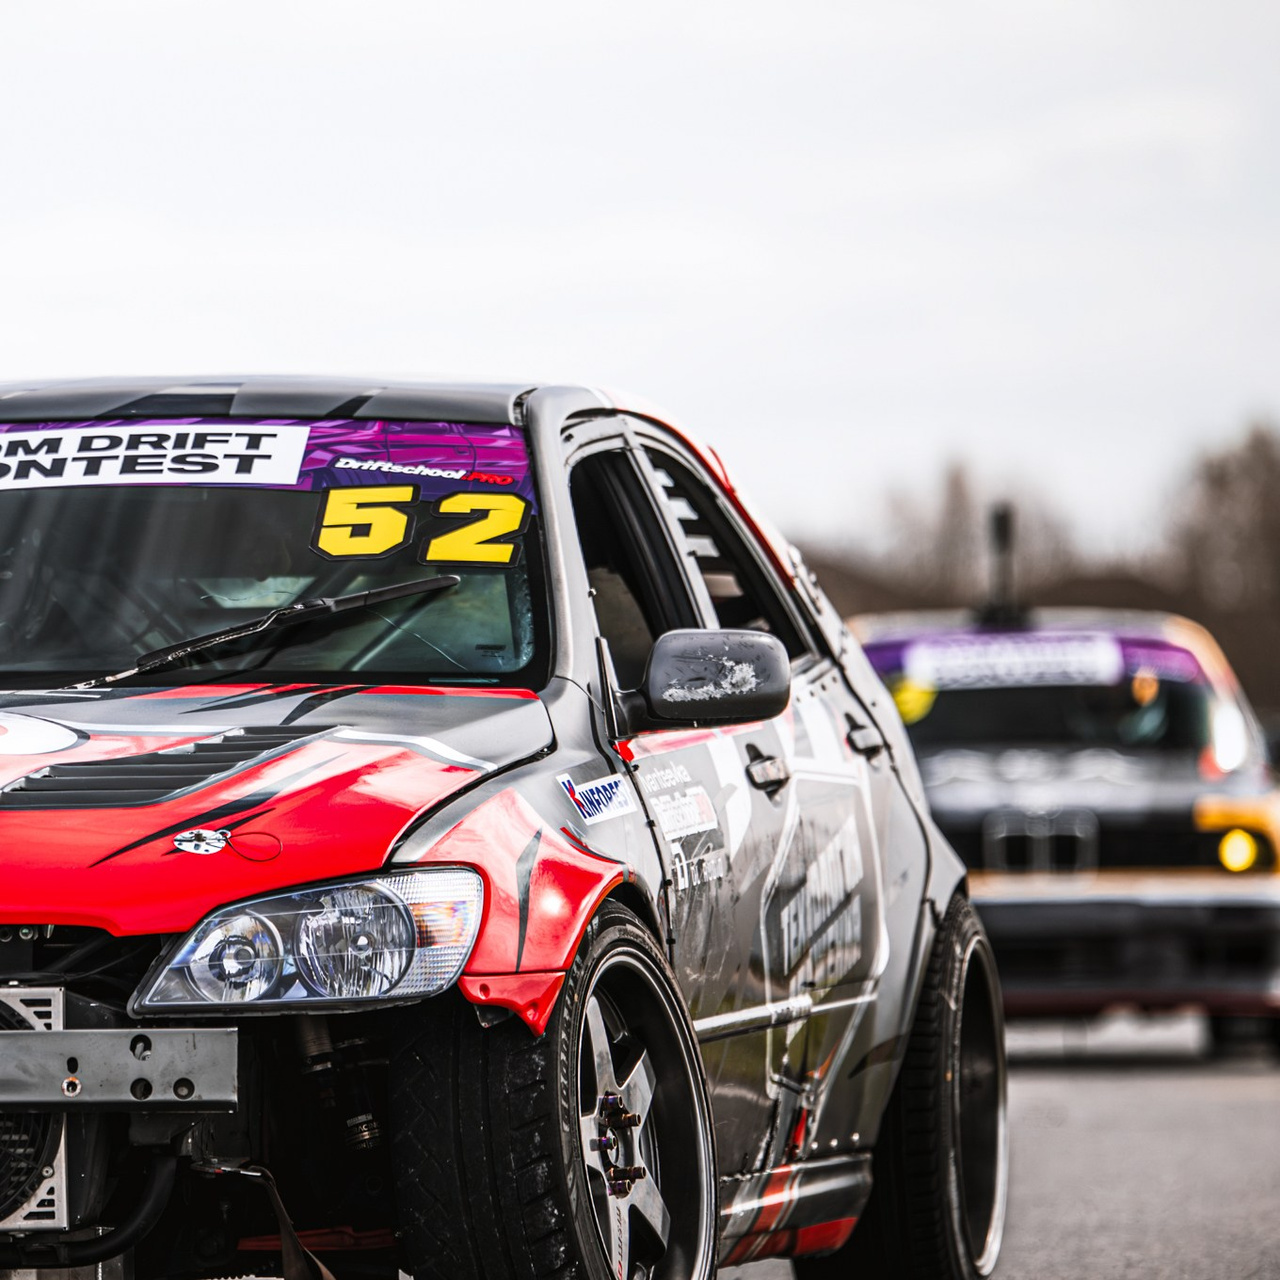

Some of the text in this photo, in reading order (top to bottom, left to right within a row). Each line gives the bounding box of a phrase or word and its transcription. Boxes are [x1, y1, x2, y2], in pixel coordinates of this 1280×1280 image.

[76, 433, 278, 453] DRIFT
[334, 457, 515, 486] Driftschool.PRO
[317, 485, 526, 564] 52
[561, 779, 630, 820] KINFORES
